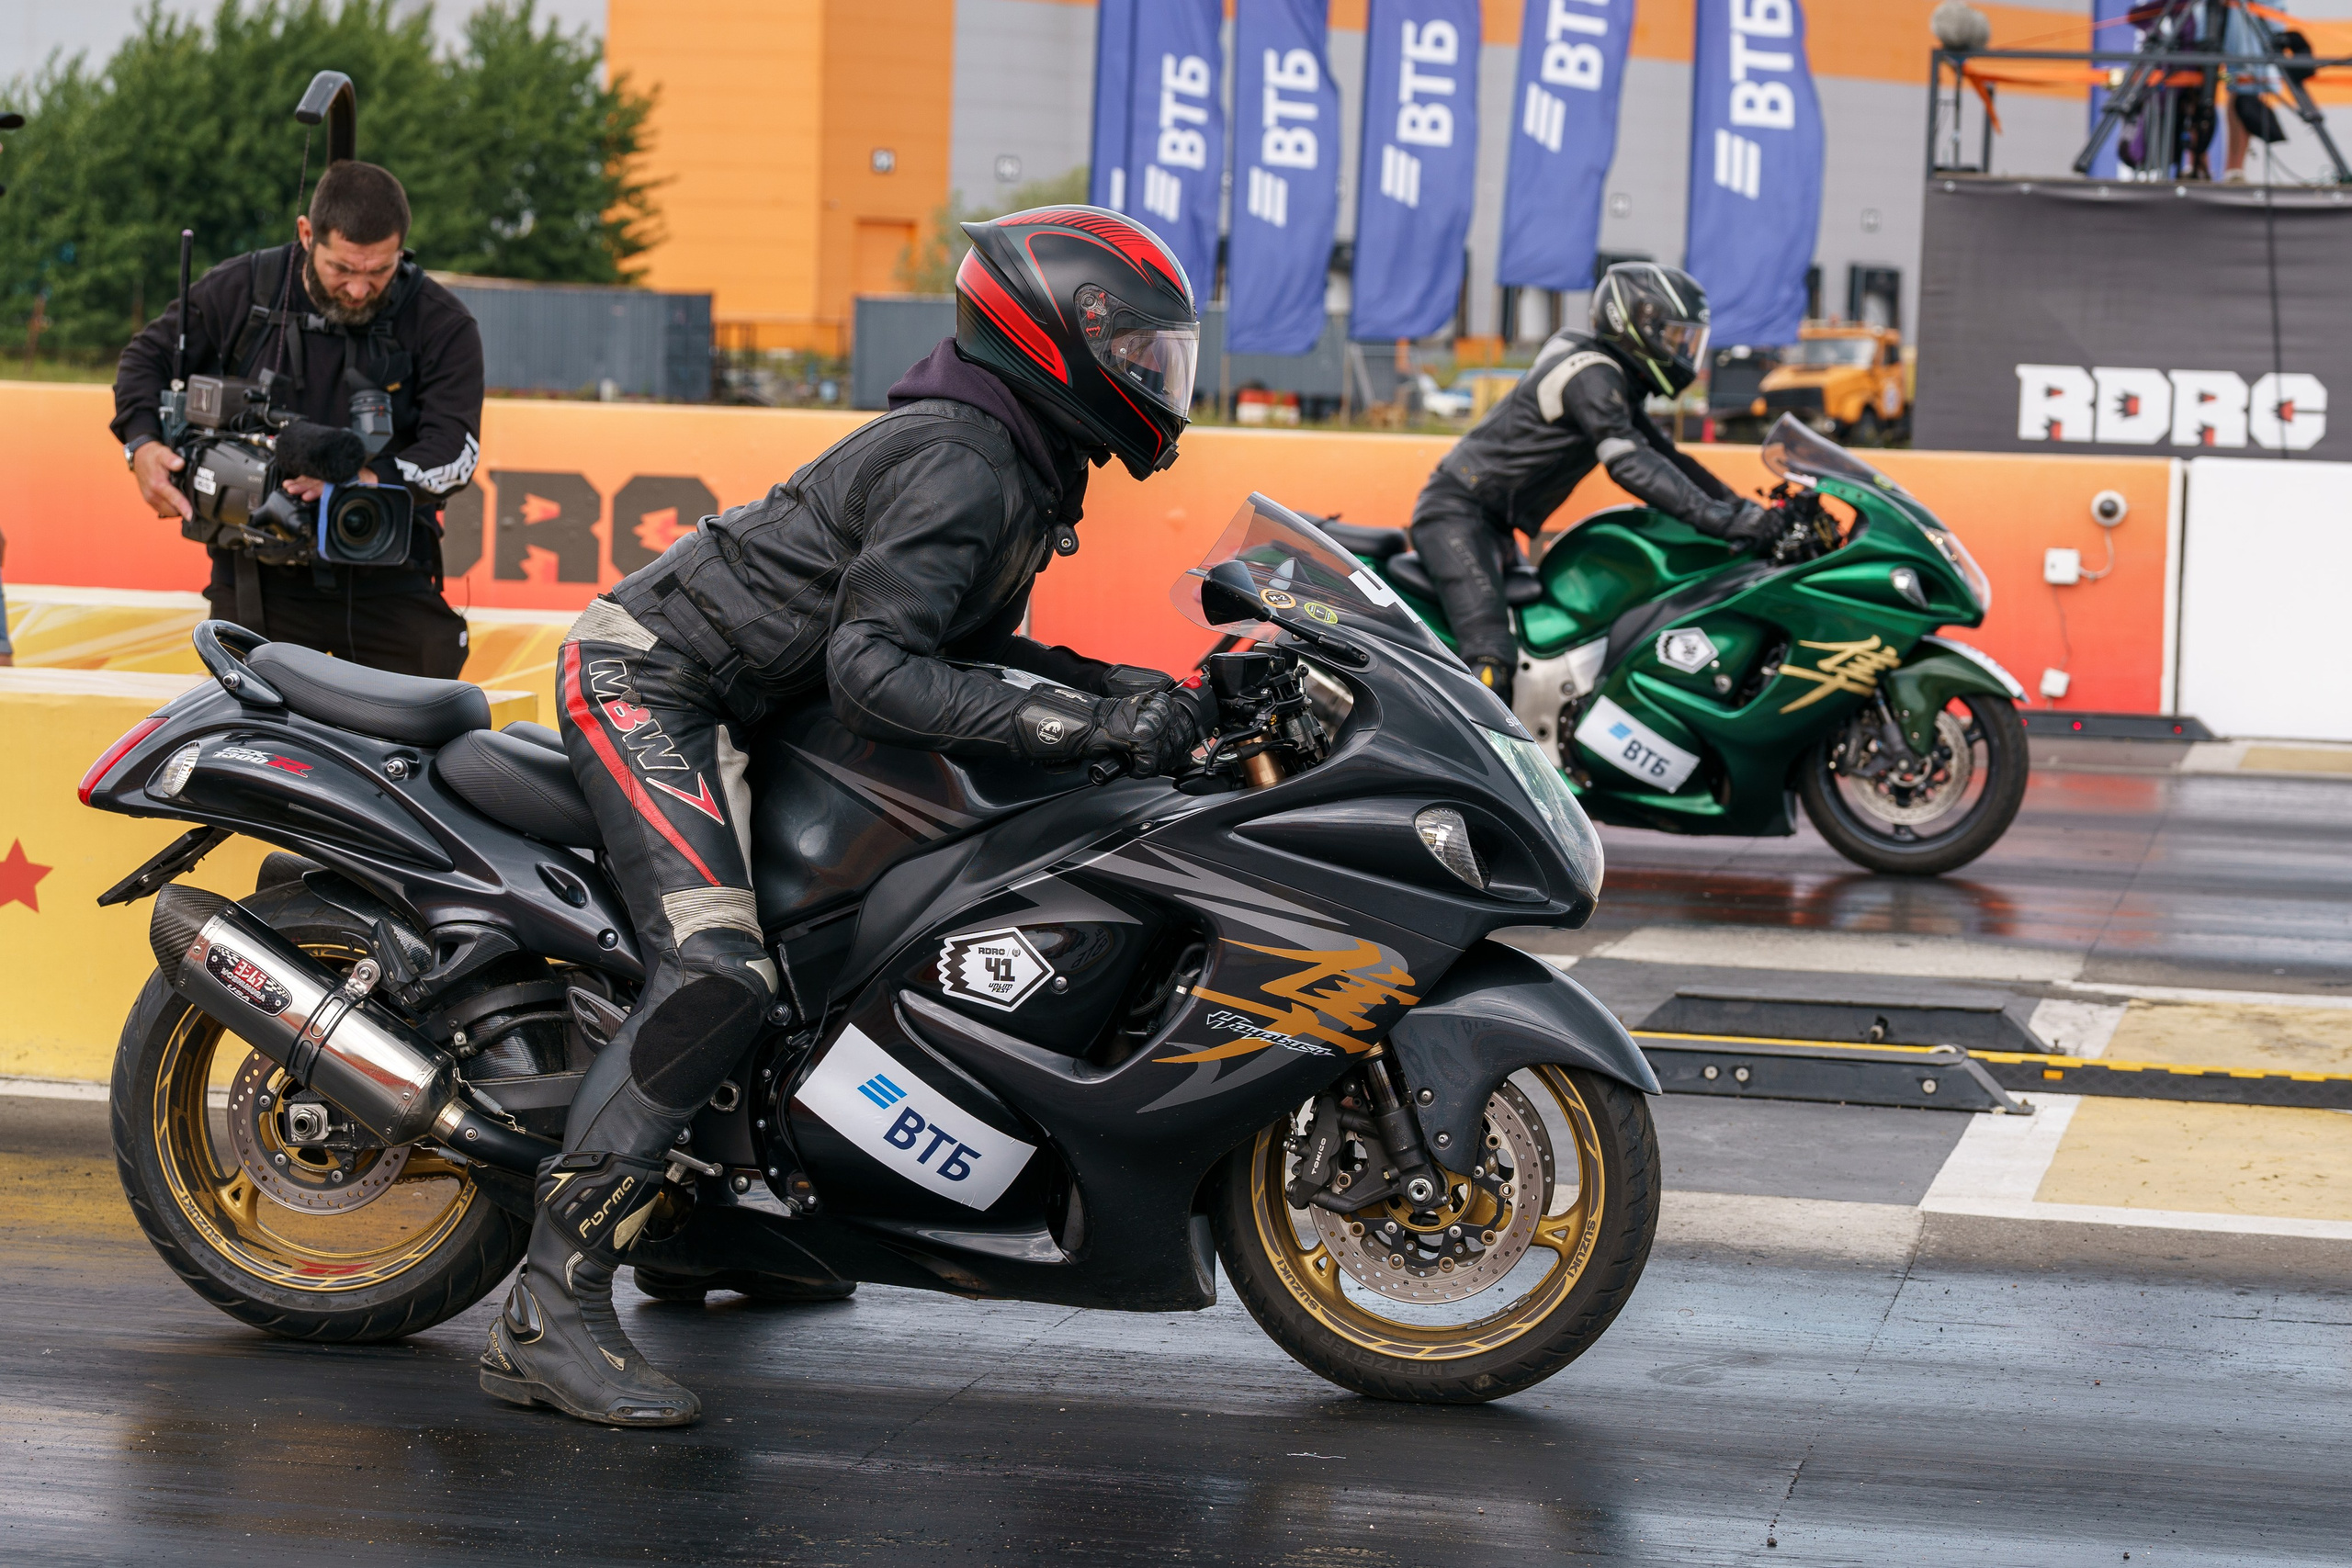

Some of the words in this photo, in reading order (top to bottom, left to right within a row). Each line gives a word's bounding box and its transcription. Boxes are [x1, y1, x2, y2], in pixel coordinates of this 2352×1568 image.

[1396, 18, 1458, 148] ВТБ
[1729, 0, 1796, 130] ВТБ
[1158, 52, 1211, 172] ВТБ
[1261, 47, 1320, 170] ВТБ
[2016, 364, 2327, 450] RDRC
[444, 469, 718, 583] RC
[266, 754, 314, 778] R
[1623, 739, 1670, 777] ВТБ
[978, 947, 1005, 955] RDRC
[985, 957, 1015, 982] 41
[227, 984, 251, 1002] USA
[1206, 1010, 1336, 1057] Hayabusa
[883, 1106, 982, 1181] ВТБ
[1311, 1137, 1327, 1175] TOKICO
[181, 1195, 223, 1245] SUZUKI
[1566, 1220, 1597, 1278] SUZUKI
[1276, 1259, 1320, 1311] SUZUKI
[1319, 1332, 1442, 1376] METZELER
